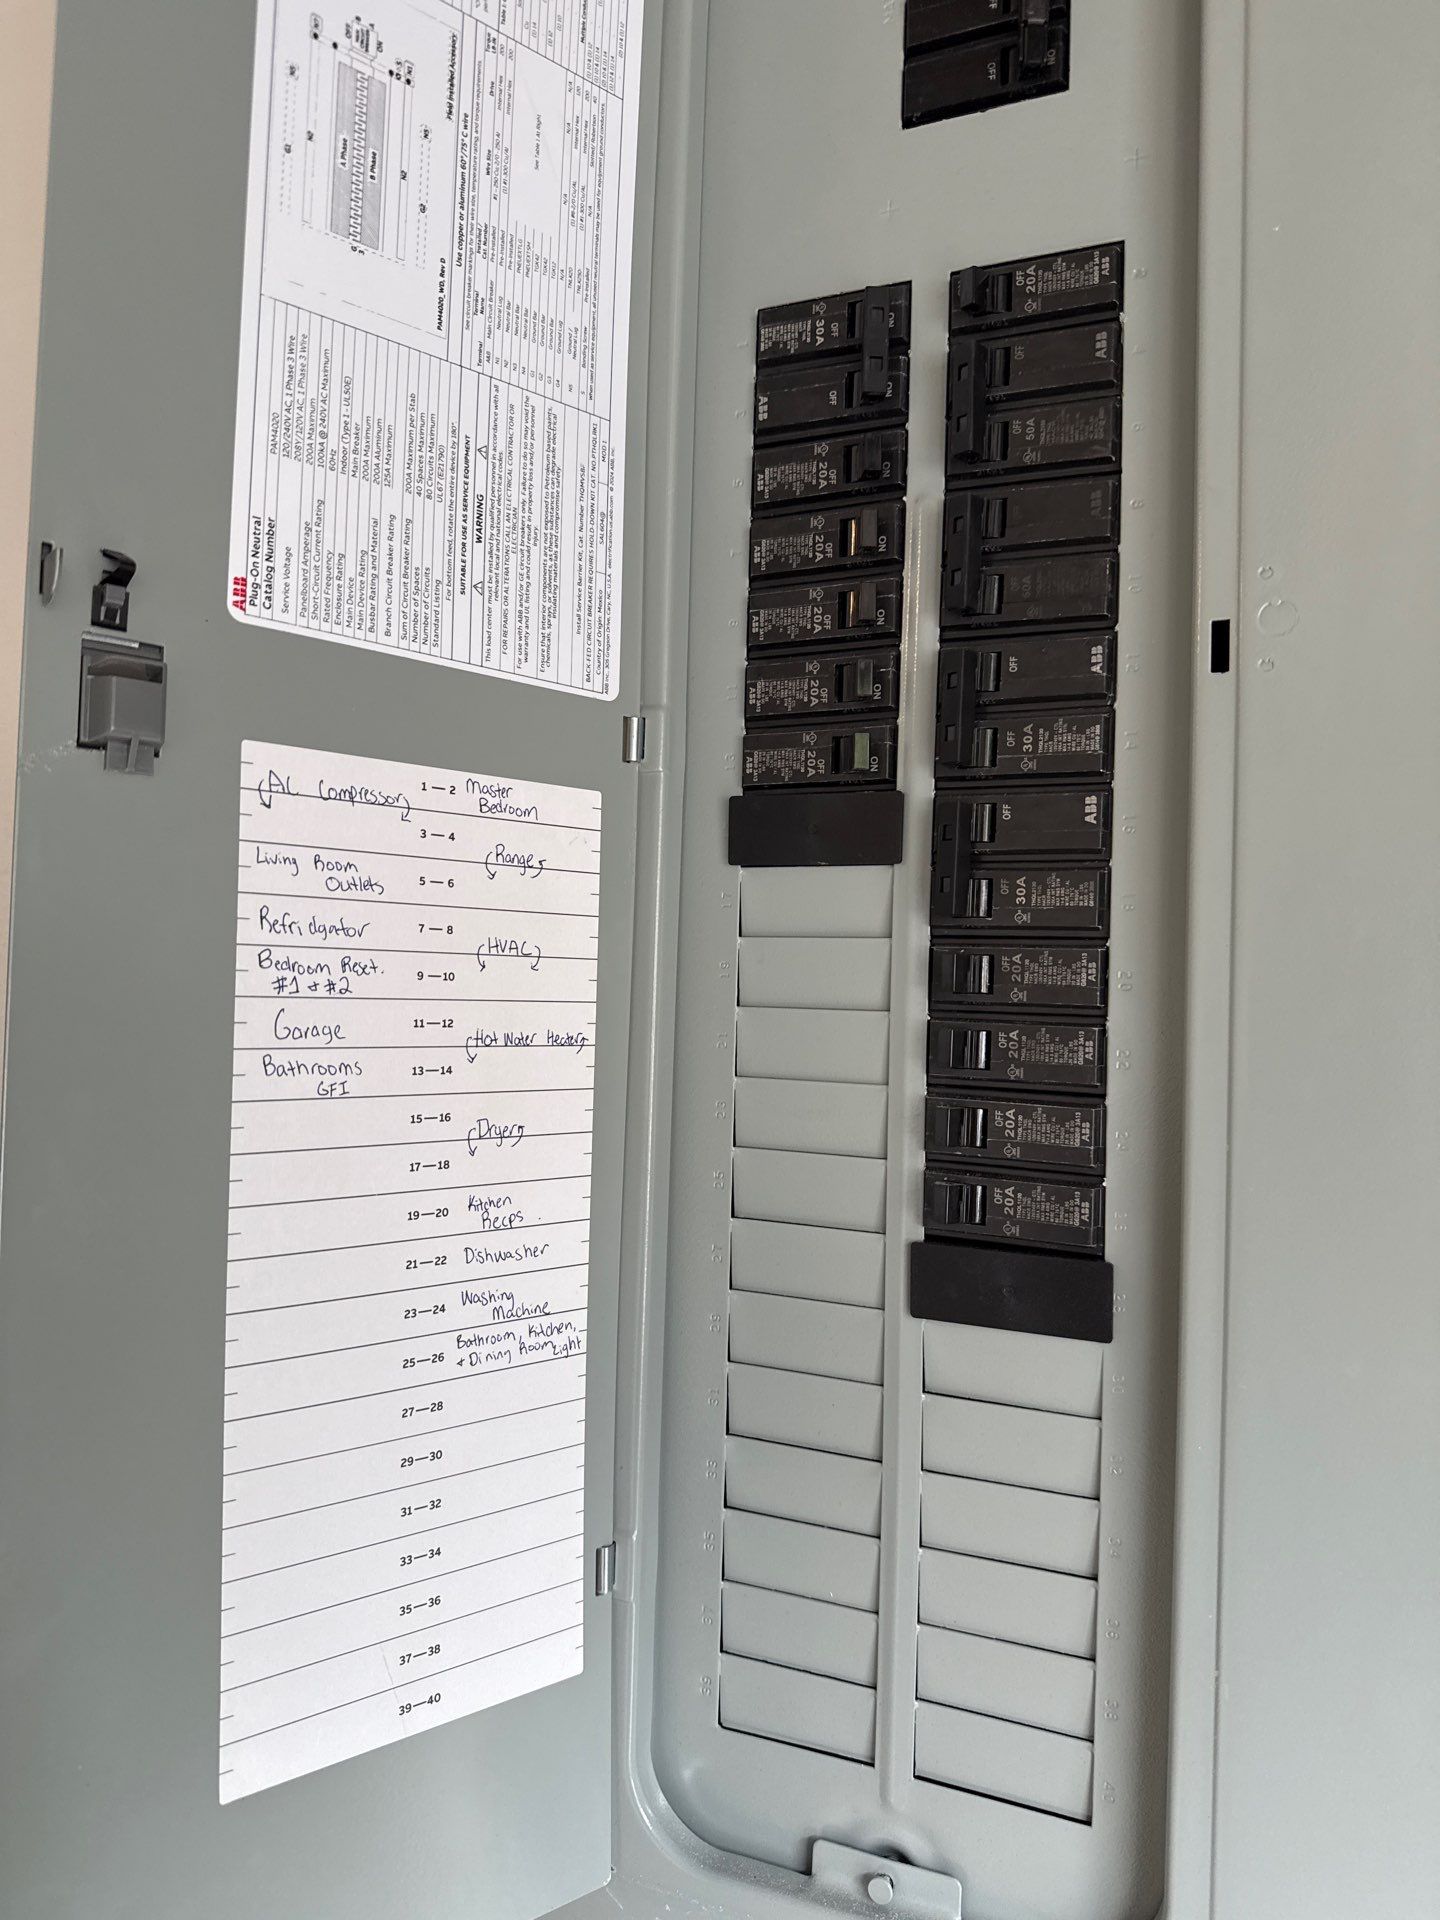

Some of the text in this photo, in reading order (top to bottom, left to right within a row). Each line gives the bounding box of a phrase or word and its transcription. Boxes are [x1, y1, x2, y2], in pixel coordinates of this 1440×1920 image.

[1048, 50, 1056, 64] ON
[987, 62, 996, 81] OFF
[459, 212, 464, 222] or
[1016, 270, 1025, 286] OFF
[1026, 264, 1036, 294] 20A
[816, 319, 824, 346] 30A
[1095, 331, 1108, 359] ABB
[1015, 346, 1024, 360] OFF
[758, 396, 768, 422] ABB
[352, 422, 360, 454] Breaker
[363, 416, 371, 458] Maximum
[1012, 420, 1022, 434] OFF
[1026, 417, 1035, 441] 50A
[818, 462, 828, 489] 20A
[882, 462, 890, 478] ON
[263, 412, 280, 610] Catalog Number PAM4020
[300, 398, 316, 618] Panelboard Amperage 200A Maximum
[315, 499, 324, 526] Rating
[462, 514, 468, 524] AS
[476, 494, 484, 544] WARNING
[388, 514, 396, 542] Rating
[314, 528, 322, 561] Current
[815, 535, 824, 562] 20A
[878, 536, 886, 552] ON
[249, 516, 262, 607] Plug-On Neutral
[283, 546, 292, 580] Voltage
[324, 550, 334, 594] Frequency
[336, 553, 345, 580] Rating
[359, 550, 368, 577] Rating
[232, 576, 248, 612] ABB
[282, 582, 290, 614] Service
[312, 563, 320, 620] Short-Circuit
[370, 574, 378, 602] Rating
[323, 596, 331, 622] Rated
[334, 582, 342, 625] Enclosure
[814, 606, 822, 634] 20A
[877, 609, 886, 626] ON
[1009, 656, 1018, 672] OFF
[1090, 645, 1103, 674] ABB
[810, 680, 819, 707] 20A
[874, 683, 882, 700] ON
[1007, 730, 1016, 747] OFF
[1022, 724, 1034, 752] 30A
[807, 751, 816, 778] 20A
[870, 756, 878, 772] ON
[319, 780, 402, 806] Compressor
[466, 779, 514, 798] Master
[479, 799, 538, 820] Bedroom
[1002, 804, 1012, 820] OFF
[1084, 795, 1098, 824] ABB
[256, 846, 358, 876] Living Room
[496, 844, 534, 876] Range
[325, 876, 384, 894] Outlets
[1000, 878, 1009, 895] OFF
[1016, 876, 1026, 905] 30A
[488, 938, 533, 956] HVAC
[258, 948, 331, 975] Bedroom
[1002, 956, 1010, 972] OFF
[1012, 953, 1022, 982] 20A
[272, 976, 299, 995] #1
[326, 976, 352, 994] #2
[274, 1008, 346, 1044] Garage
[474, 1029, 583, 1046] Hot Water Heater
[998, 1032, 1008, 1048] OFF
[1008, 1030, 1020, 1059] 20A
[1085, 1040, 1094, 1060] ABB
[262, 1054, 363, 1077] Bathrooms
[317, 1082, 350, 1096] GFI
[995, 1110, 1004, 1127] OFF
[1005, 1108, 1016, 1138] 20A
[1082, 1122, 1090, 1142] ABB
[477, 1118, 516, 1147] Dryer
[468, 1195, 512, 1214] Kitchen
[994, 1187, 1003, 1204] OFF
[1004, 1186, 1015, 1216] 20A
[1081, 1201, 1090, 1222] ABB
[464, 1244, 550, 1264] Dishwasher
[461, 1290, 514, 1306] Washing
[492, 1302, 552, 1321] Machine
[469, 1348, 512, 1367] Dining
[519, 1339, 556, 1356] Room
[552, 1340, 582, 1358] Light
